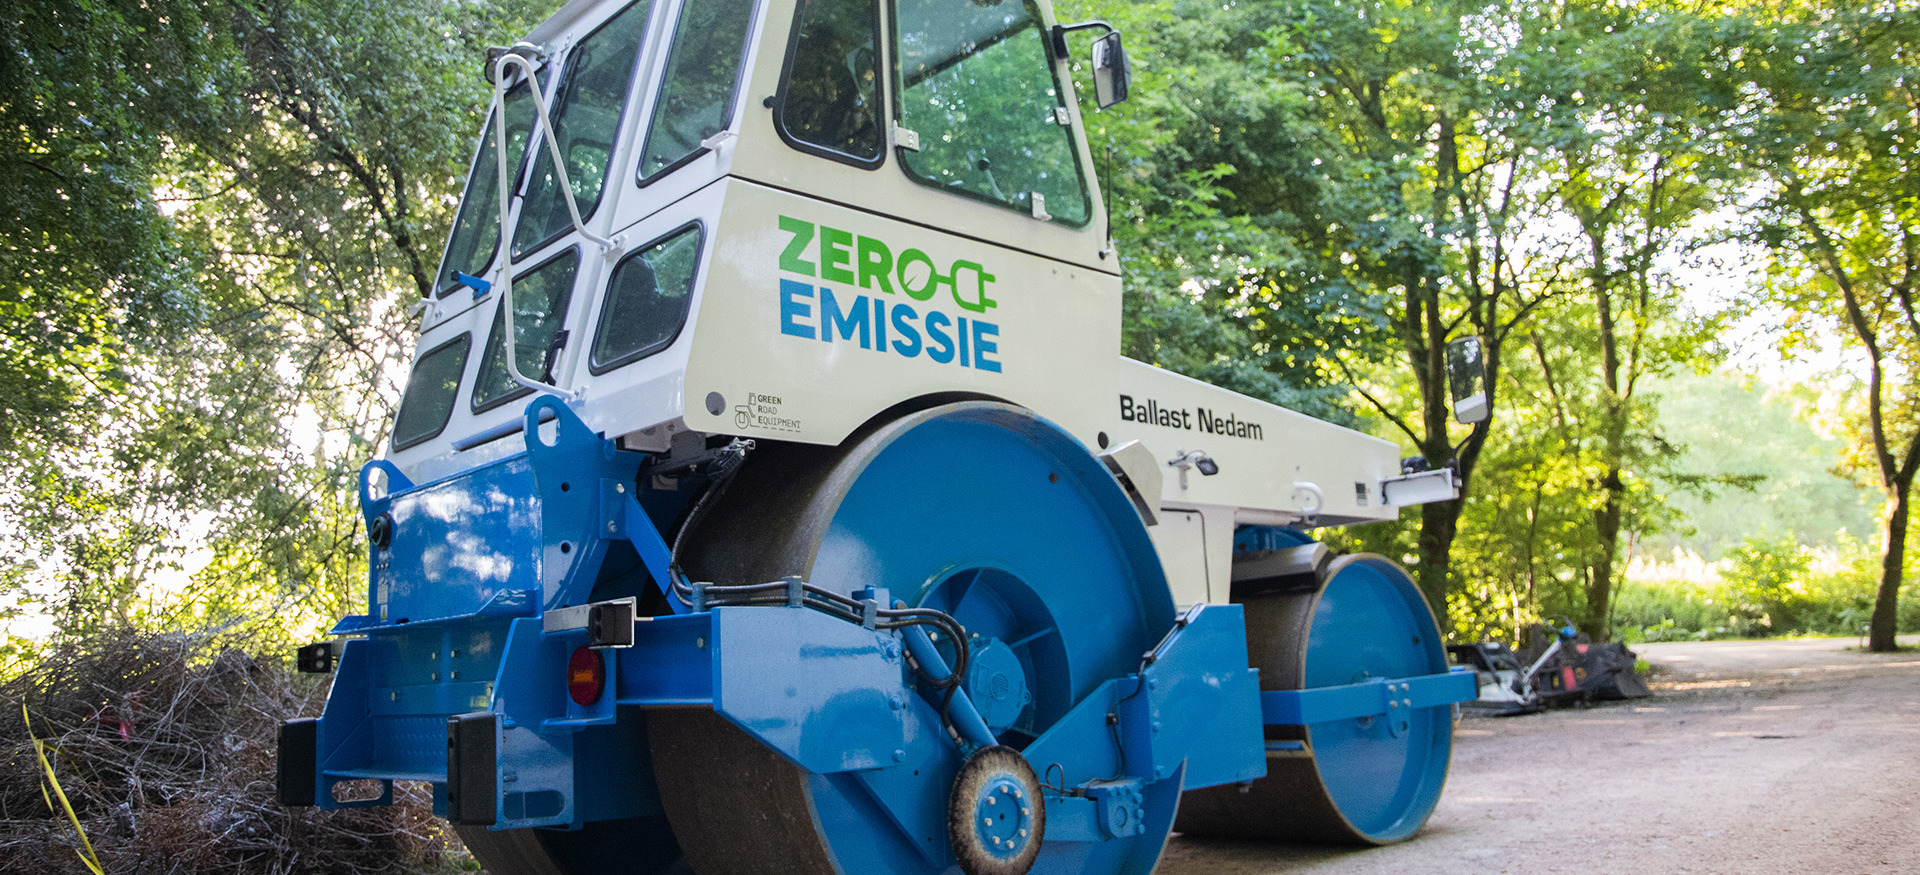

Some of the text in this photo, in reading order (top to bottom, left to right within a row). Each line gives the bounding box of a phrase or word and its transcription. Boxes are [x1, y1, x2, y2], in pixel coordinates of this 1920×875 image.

[779, 214, 938, 301] ZERO
[780, 278, 1002, 374] EMISSIE
[757, 394, 782, 405] GREEN
[757, 405, 778, 415] ROAD
[758, 416, 801, 428] EQUIPMENT
[1120, 394, 1264, 441] Ballast Nedam
